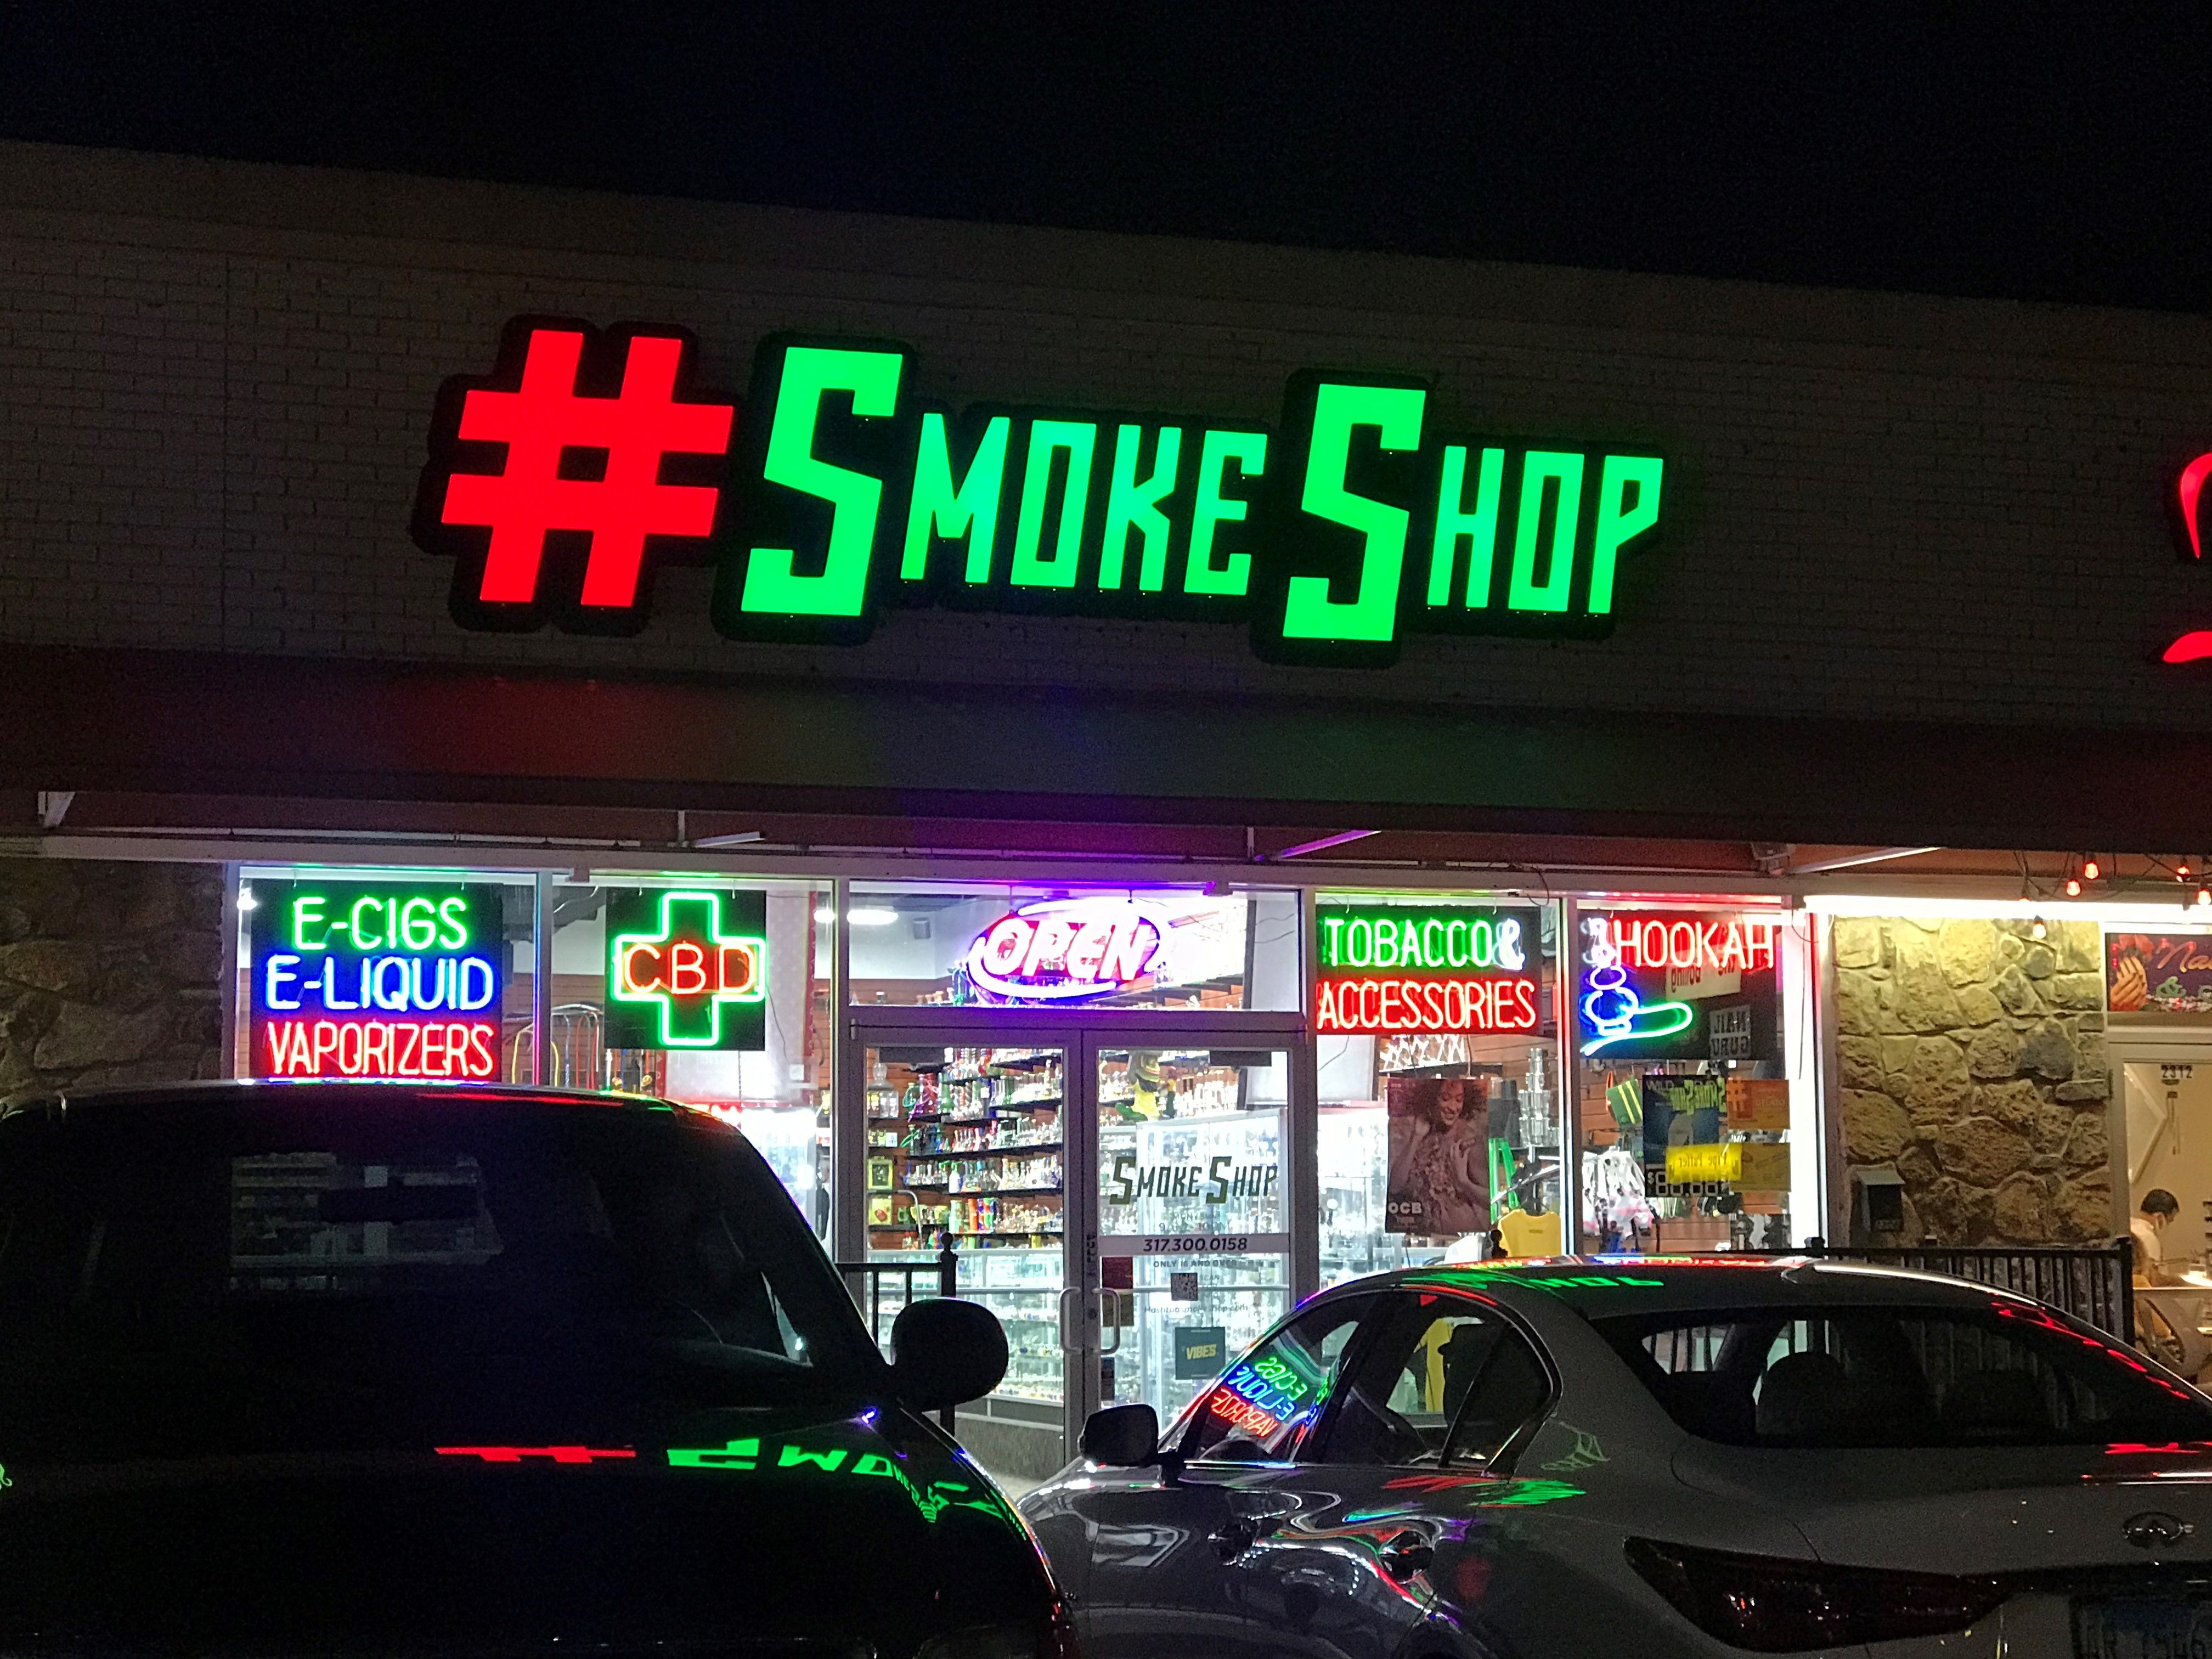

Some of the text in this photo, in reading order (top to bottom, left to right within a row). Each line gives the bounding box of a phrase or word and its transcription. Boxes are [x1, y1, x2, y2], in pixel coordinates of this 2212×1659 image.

[1283, 383, 1663, 641] SHOP
[294, 896, 467, 950] E-CIGS
[1614, 919, 1774, 969] HOOKAH
[624, 942, 755, 994] CBD
[986, 917, 1154, 980] OPEN
[267, 955, 493, 1011] E-LIQUID
[1317, 980, 1536, 1030] ACCESSORIES
[267, 1021, 494, 1076] VAPORIZERS
[2162, 1064, 2192, 1079] 2312
[1205, 1155, 1278, 1204] SHOP
[1388, 1201, 1422, 1214] OCB
[1143, 1237, 1248, 1252] 317.300.0158
[1186, 1344, 1217, 1359] VIBES
